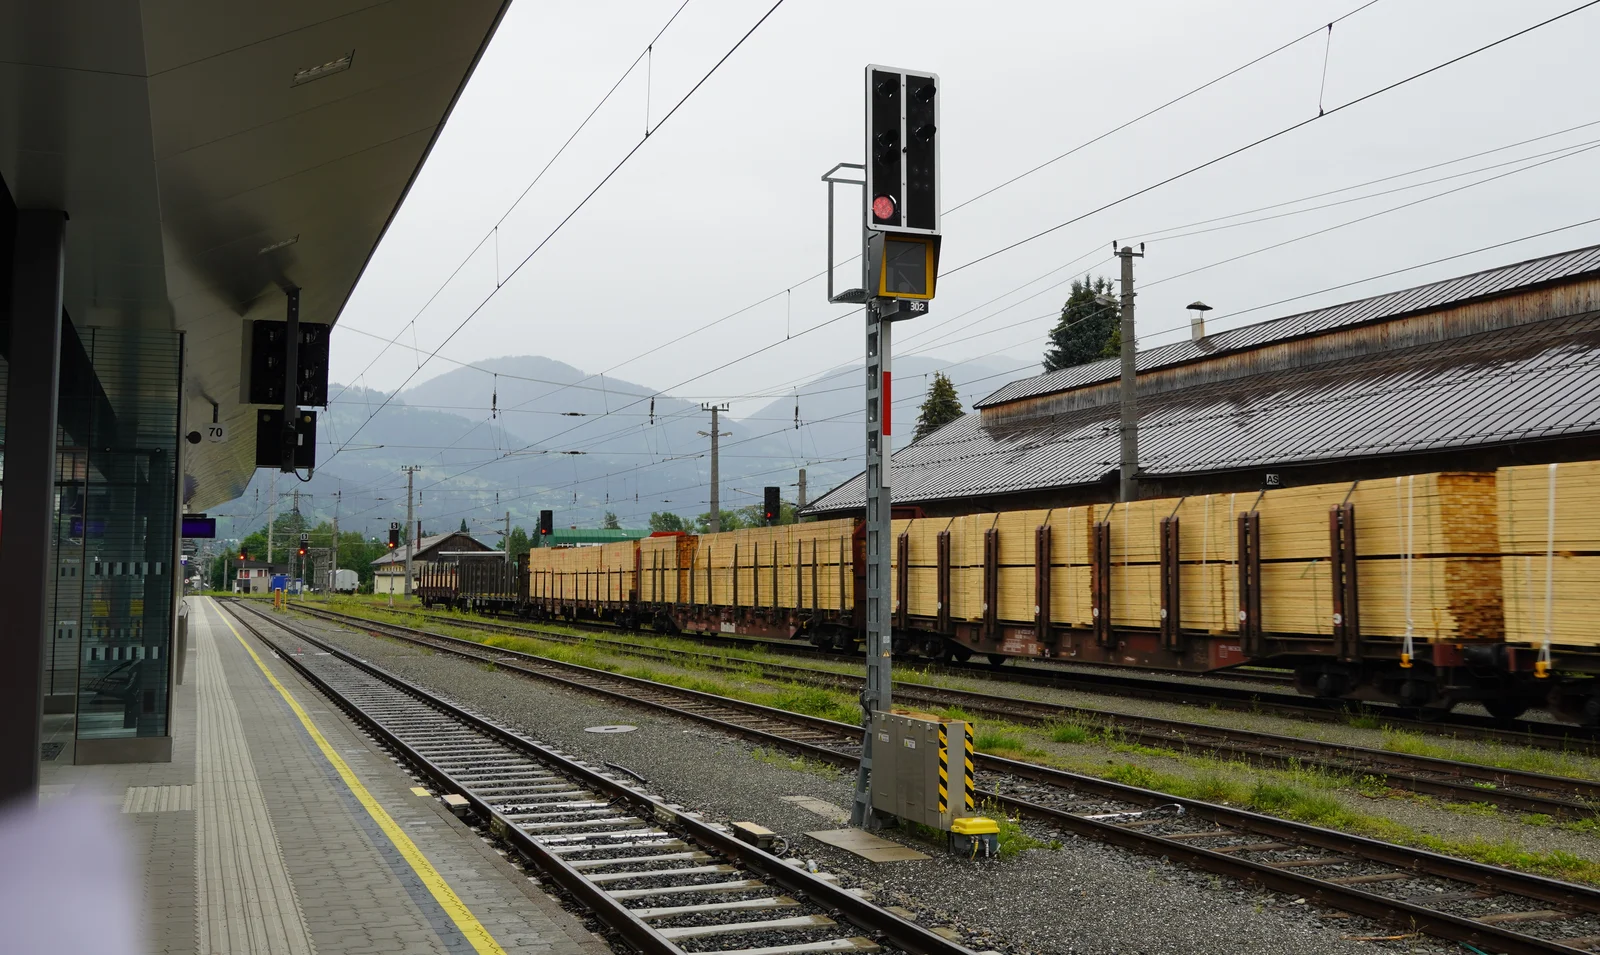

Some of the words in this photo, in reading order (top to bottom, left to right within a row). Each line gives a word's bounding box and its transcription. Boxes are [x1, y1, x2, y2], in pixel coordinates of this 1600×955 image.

[910, 302, 925, 311] 302
[208, 427, 223, 437] 70
[1266, 475, 1279, 484] AS
